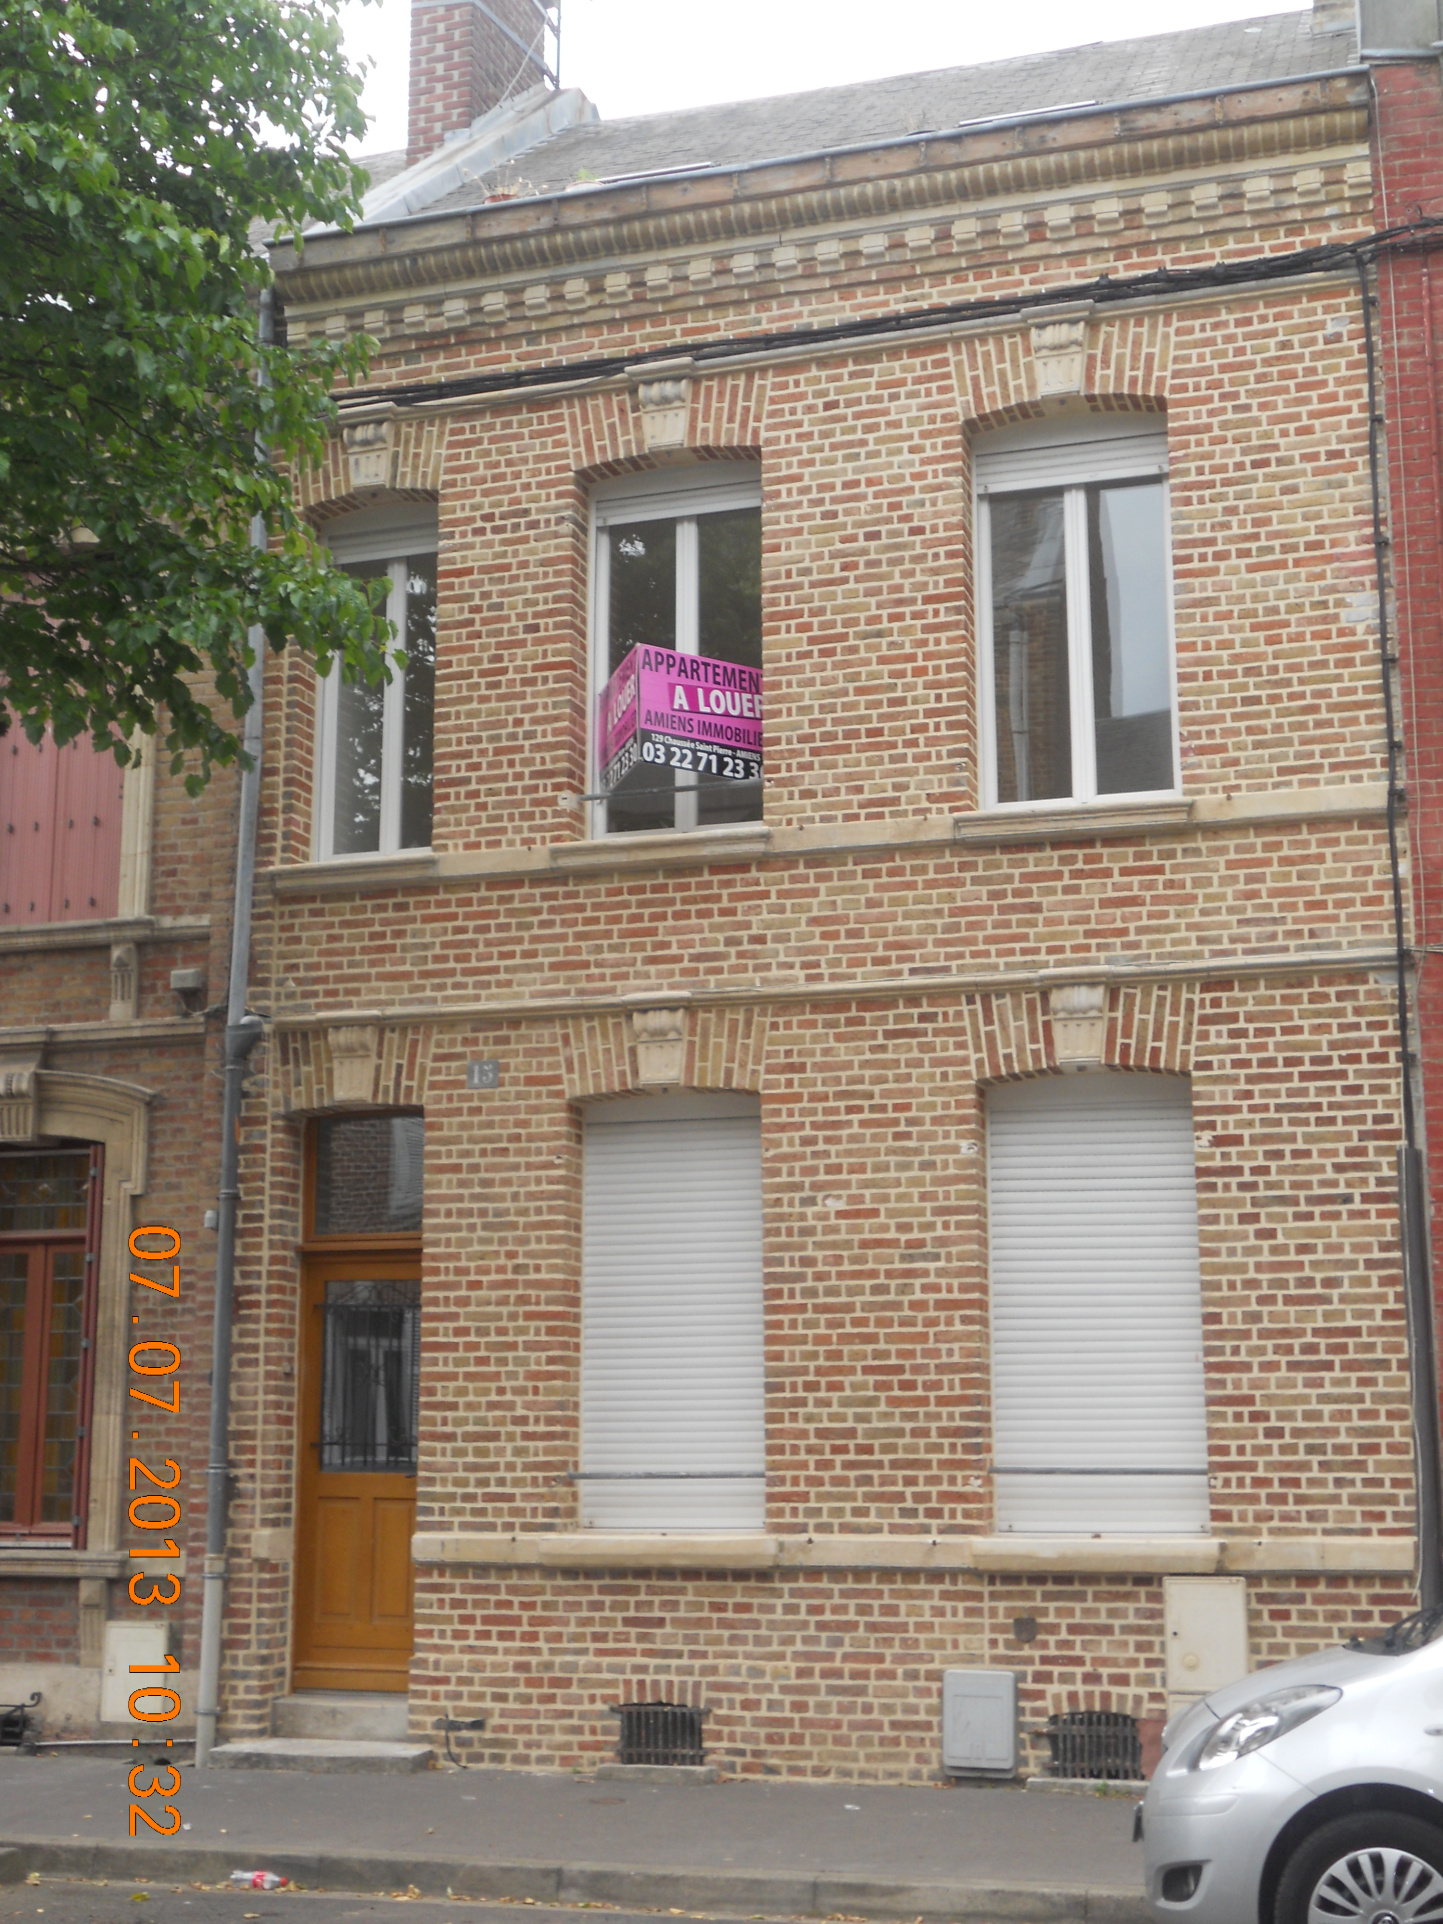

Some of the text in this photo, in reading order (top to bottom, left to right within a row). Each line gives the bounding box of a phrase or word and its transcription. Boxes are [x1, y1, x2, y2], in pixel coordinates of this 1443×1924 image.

[673, 685, 689, 710] A
[645, 709, 694, 733] AMIENS
[642, 741, 666, 764] 03
[670, 746, 693, 769] 22
[697, 751, 718, 774] 71
[722, 756, 745, 779] 23
[651, 733, 663, 743] 129
[695, 742, 712, 752] Saint
[713, 745, 732, 756] Pierre
[736, 750, 761, 761] AMIENS
